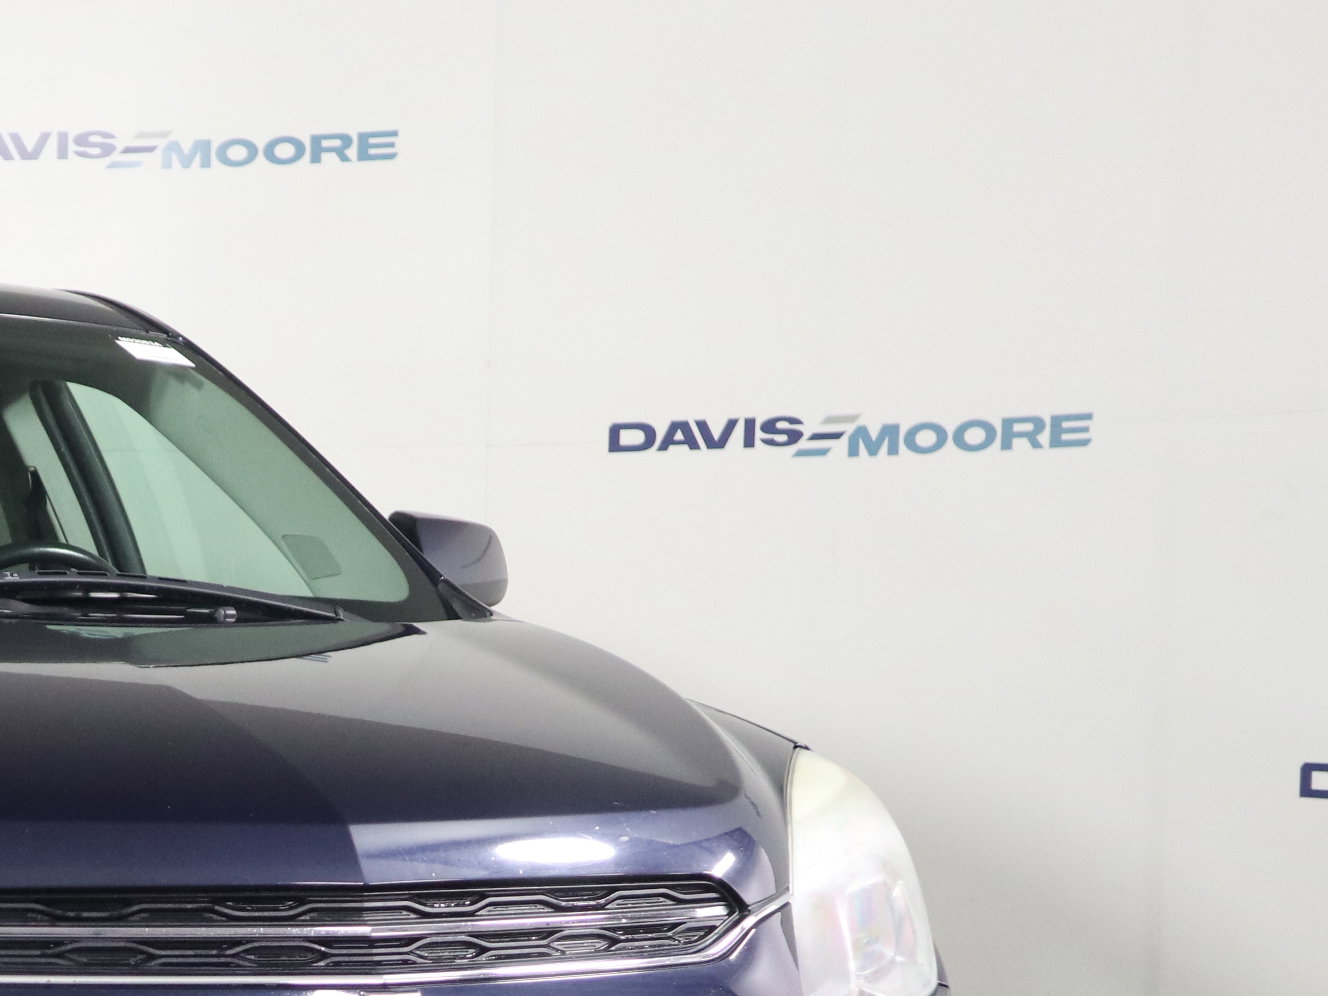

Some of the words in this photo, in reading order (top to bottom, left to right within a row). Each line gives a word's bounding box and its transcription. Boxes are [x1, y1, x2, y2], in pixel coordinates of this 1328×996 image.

[160, 129, 399, 169] MOORE
[607, 415, 806, 453] DAVIS
[846, 412, 1094, 458] MOORE
